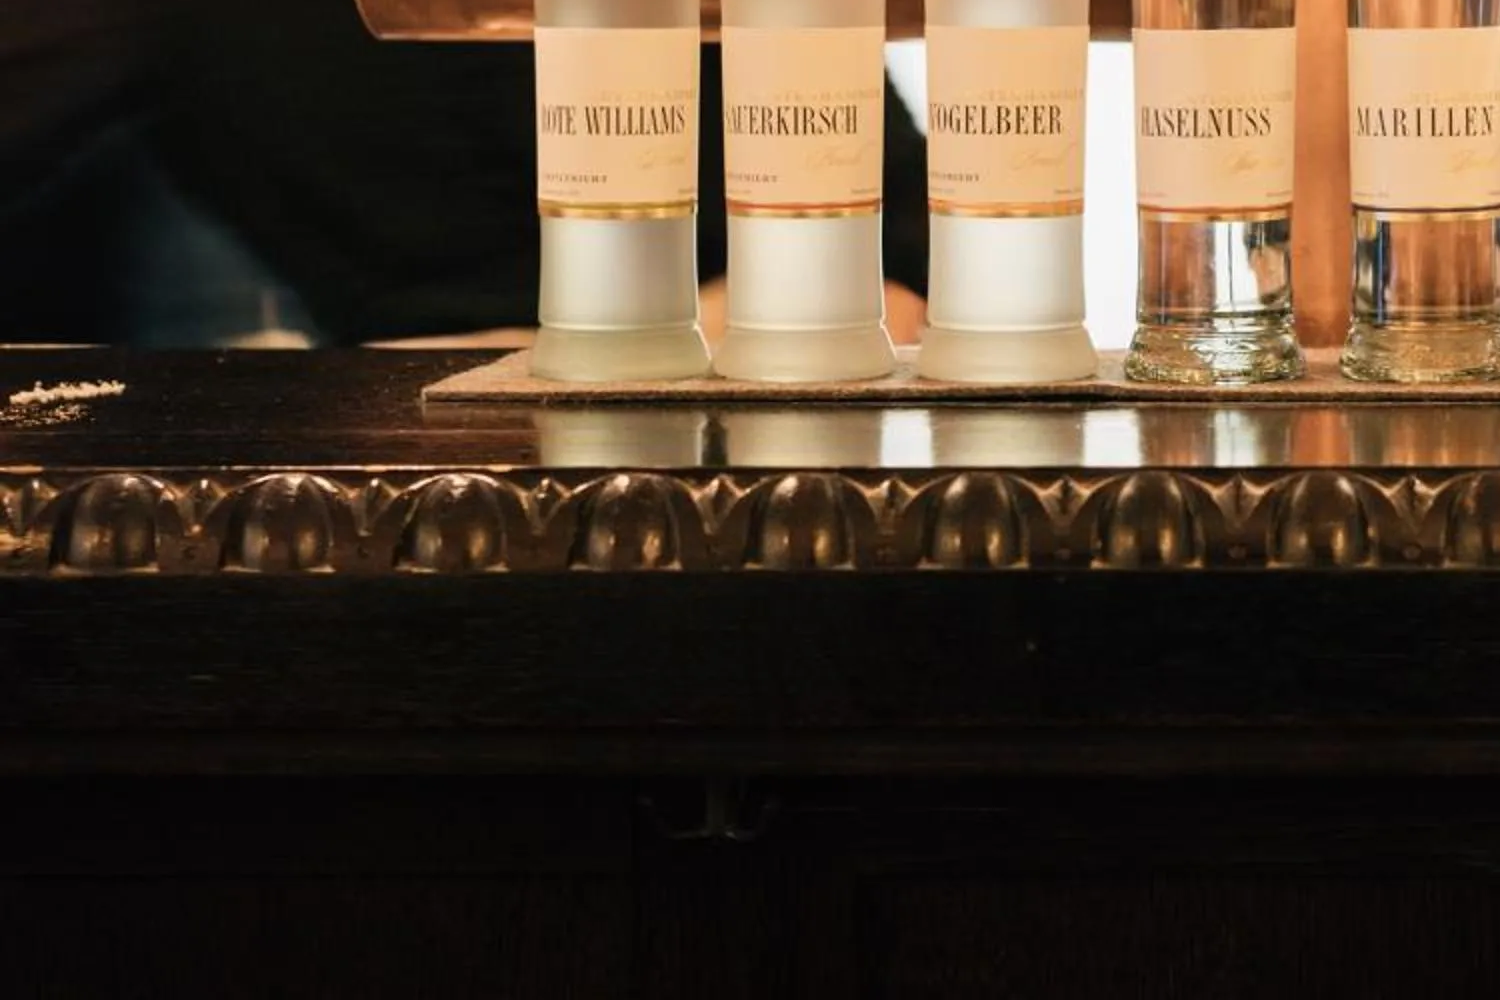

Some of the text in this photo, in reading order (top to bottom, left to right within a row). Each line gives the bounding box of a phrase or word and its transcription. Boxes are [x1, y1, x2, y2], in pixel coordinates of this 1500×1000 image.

[541, 104, 686, 136] OTE WILLIAMS
[1141, 106, 1273, 139] HASELNUSS
[1357, 105, 1496, 138] MARILLEN
